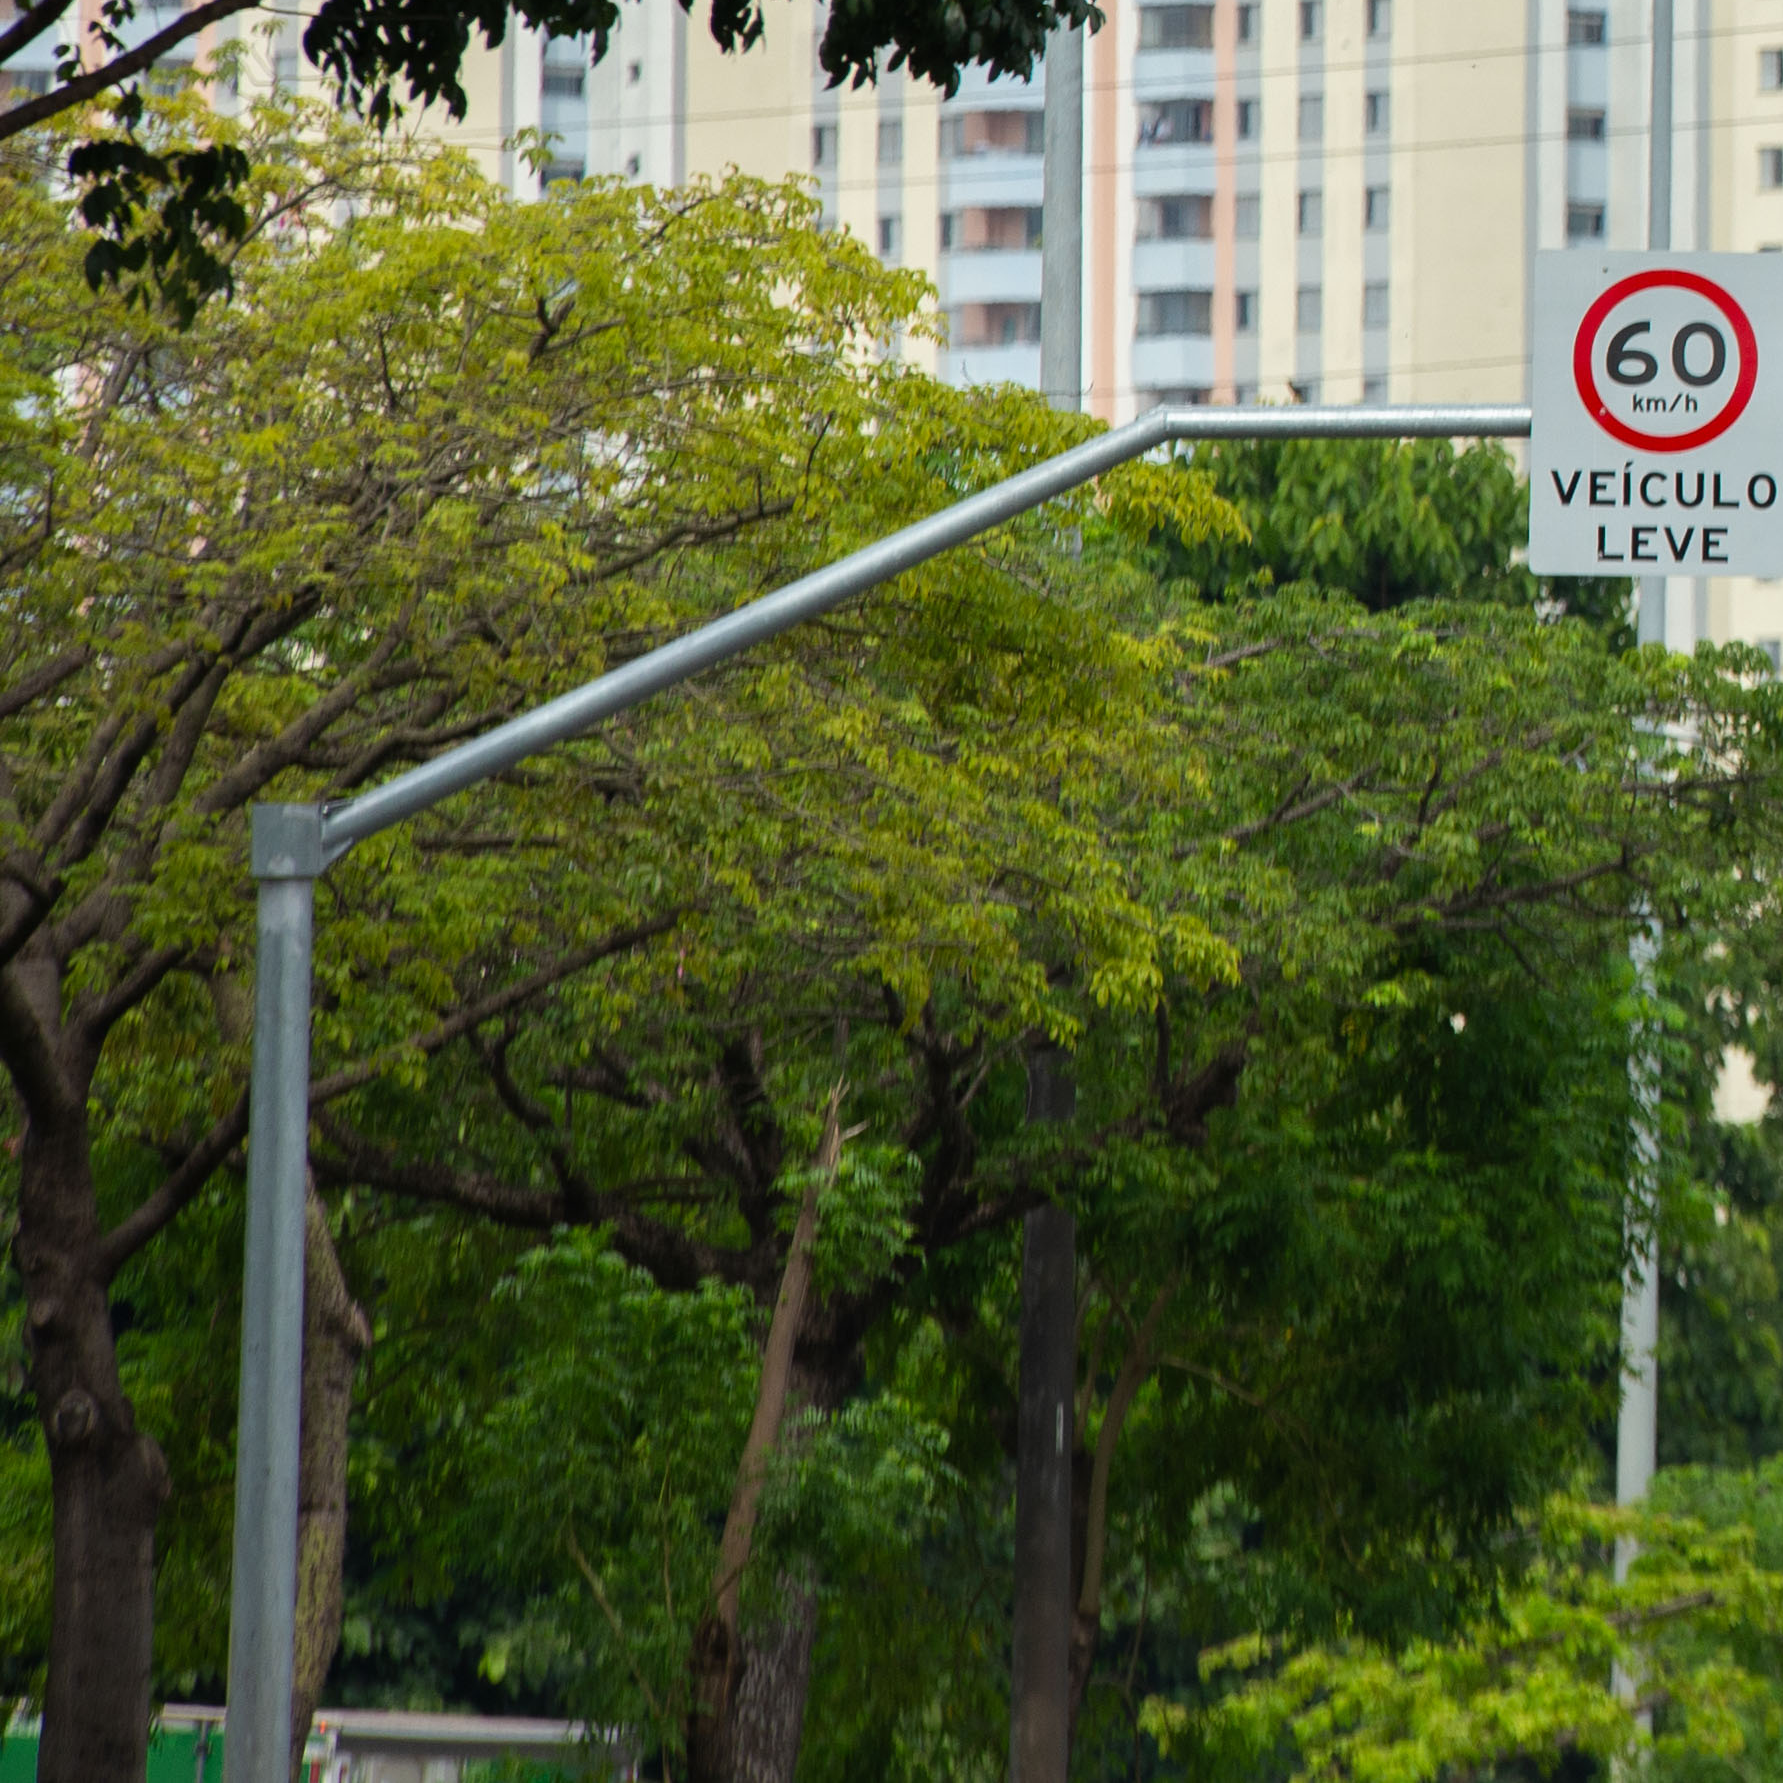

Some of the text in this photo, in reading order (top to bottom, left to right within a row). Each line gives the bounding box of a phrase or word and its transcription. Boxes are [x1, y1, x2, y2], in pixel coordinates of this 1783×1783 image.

[1605, 318, 1727, 387] 60
[1632, 392, 1699, 414] km/h
[1550, 460, 1778, 510] VEÍCULO
[1597, 524, 1729, 564] LEVE
